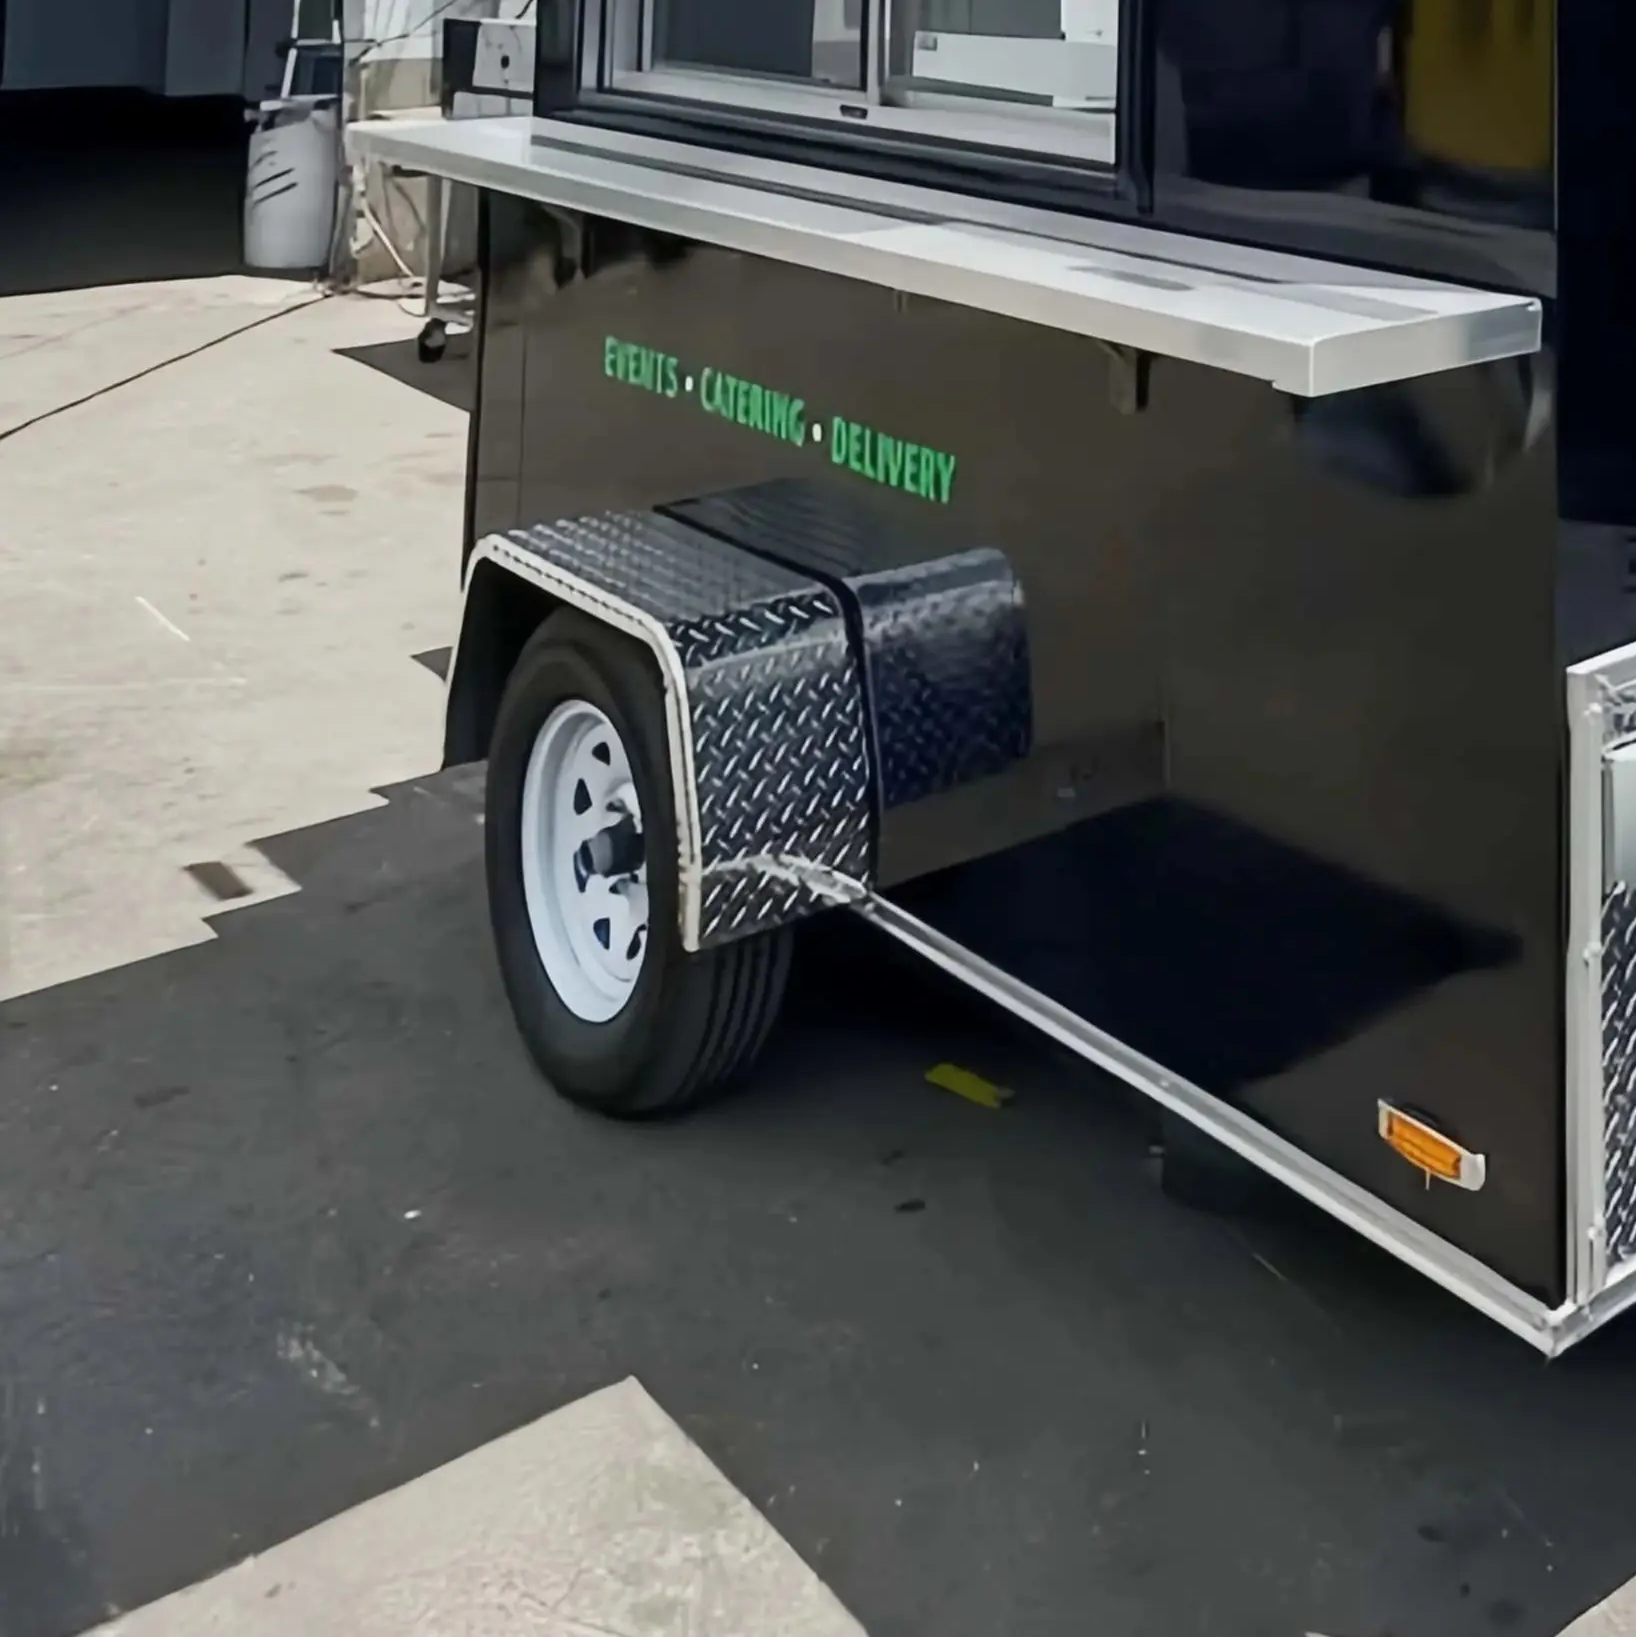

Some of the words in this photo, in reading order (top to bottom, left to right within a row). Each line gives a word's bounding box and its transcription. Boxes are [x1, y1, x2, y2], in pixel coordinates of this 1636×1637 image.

[604, 335, 680, 398] EVENTS
[699, 366, 806, 447] CATERING
[831, 415, 957, 504] DELIVERY
